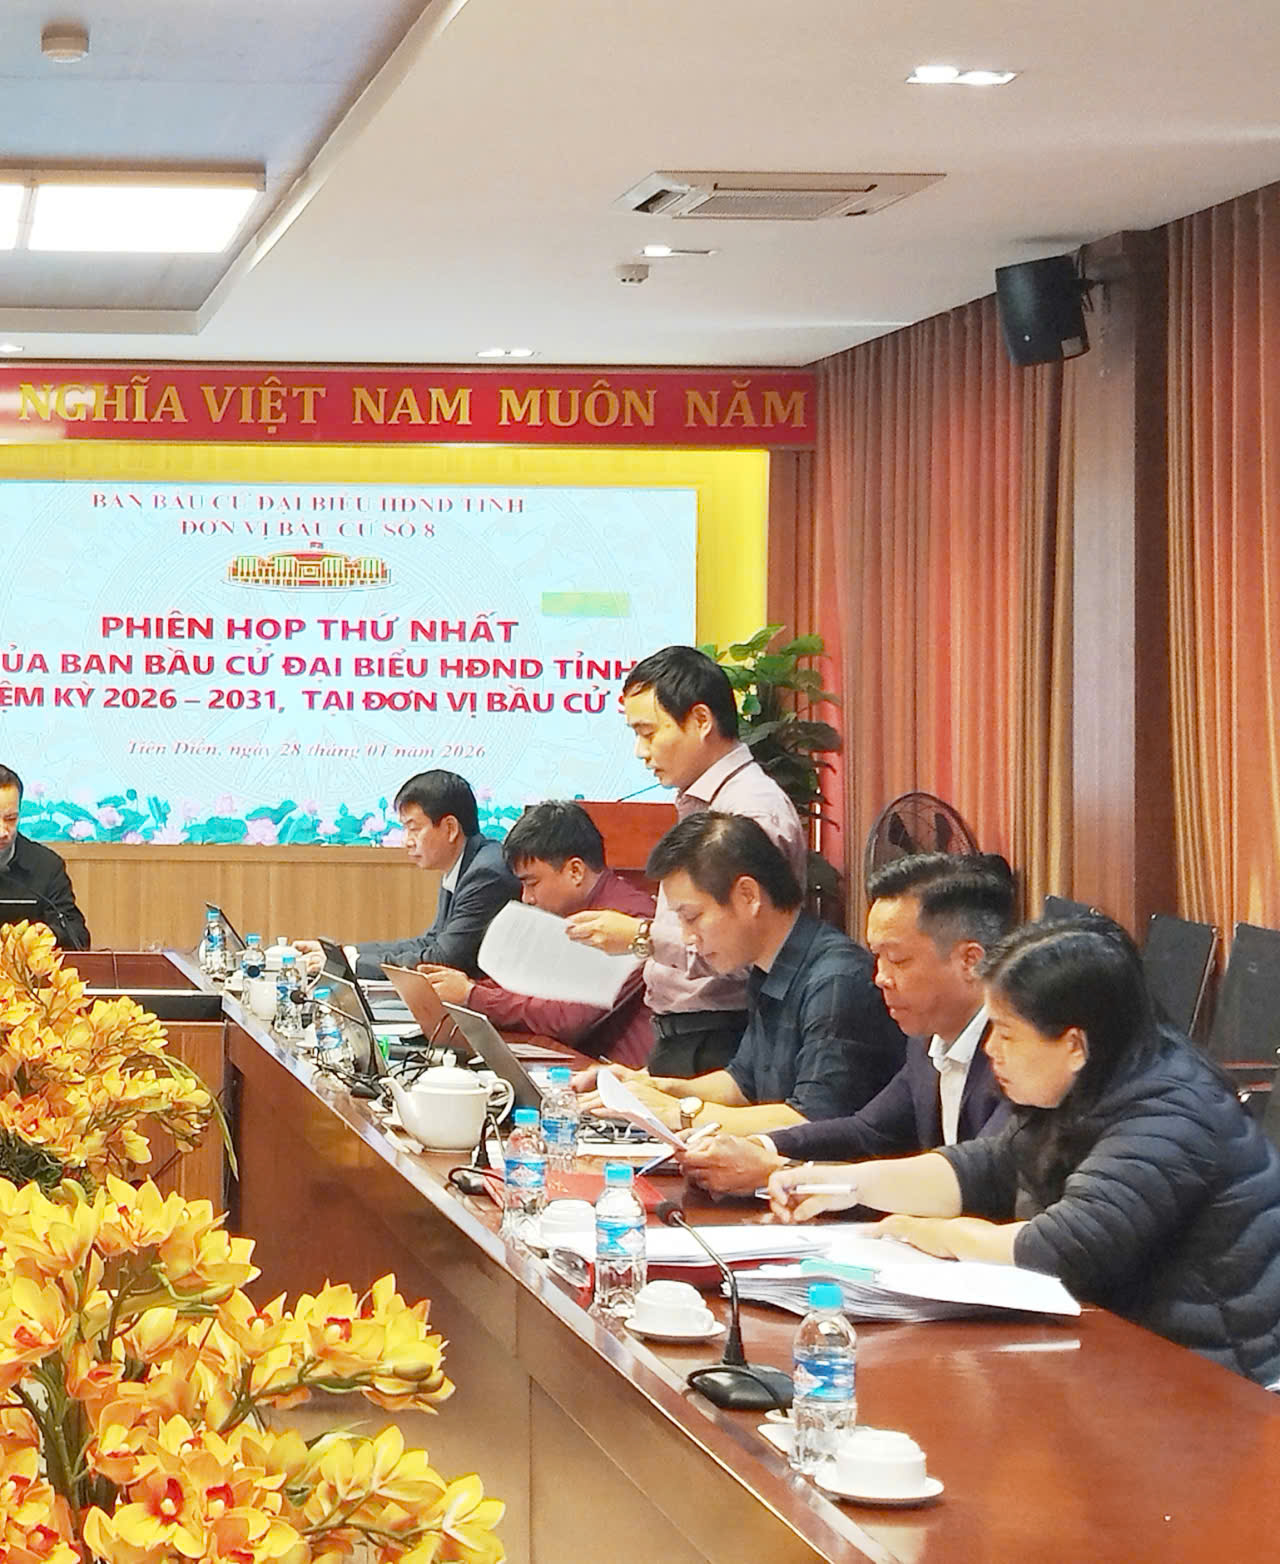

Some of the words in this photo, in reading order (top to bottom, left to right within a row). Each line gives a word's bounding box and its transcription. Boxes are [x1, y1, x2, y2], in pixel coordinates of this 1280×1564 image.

[18, 375, 187, 424] NGHĨA
[202, 377, 327, 434] VIỆT
[351, 387, 473, 426] NAM
[498, 379, 656, 428] MUÔN
[684, 379, 807, 429] NĂM
[93, 494, 142, 509] BAN
[424, 523, 436, 538] 8
[102, 611, 214, 640] PHIÊN
[317, 611, 398, 642] THỨ
[410, 611, 519, 643] NHẤT
[61, 653, 133, 675] BAN
[144, 648, 216, 676] BẦU
[225, 646, 275, 677] CỬ
[282, 656, 342, 683] ĐẠI
[354, 648, 428, 678] BIỂU
[440, 657, 543, 680] HĐND
[553, 650, 637, 680] TỈNH
[54, 680, 94, 708] KỲ
[103, 687, 178, 710] 2026
[207, 688, 286, 713] 2031,
[302, 690, 355, 718] TẠI
[362, 690, 438, 712] ĐƠN
[447, 691, 478, 718] VỊ
[486, 684, 555, 713] BẦU
[563, 684, 611, 714] CỬ
[279, 743, 302, 757] 28
[365, 744, 387, 758] 01
[440, 744, 486, 759] 2026
